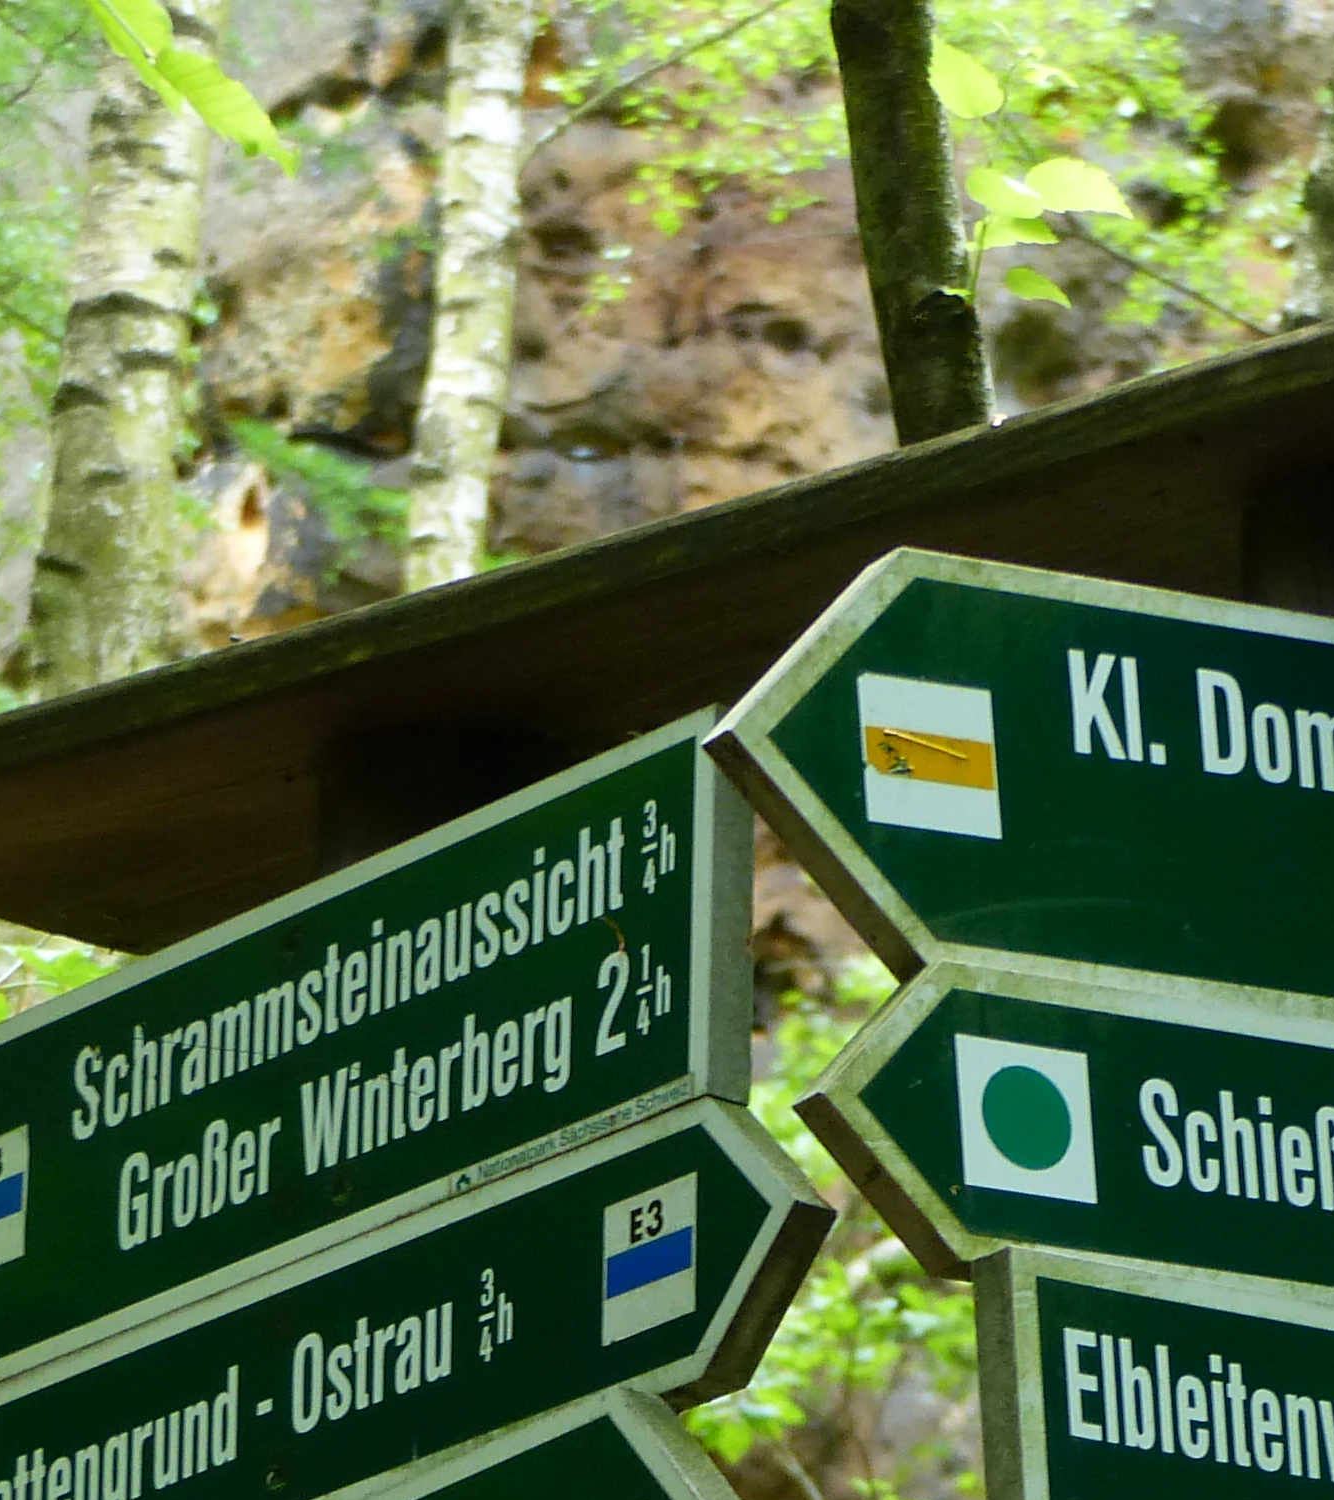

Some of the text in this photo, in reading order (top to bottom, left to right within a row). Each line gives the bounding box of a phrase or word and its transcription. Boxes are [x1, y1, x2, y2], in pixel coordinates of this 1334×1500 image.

[1066, 647, 1167, 768] Kl.
[70, 816, 625, 1141] Schrammsteinaussicht
[117, 1114, 282, 1253] Großer
[299, 995, 573, 1177] Winterberg
[630, 1199, 664, 1245] E3
[290, 1300, 454, 1435] Ostrau
